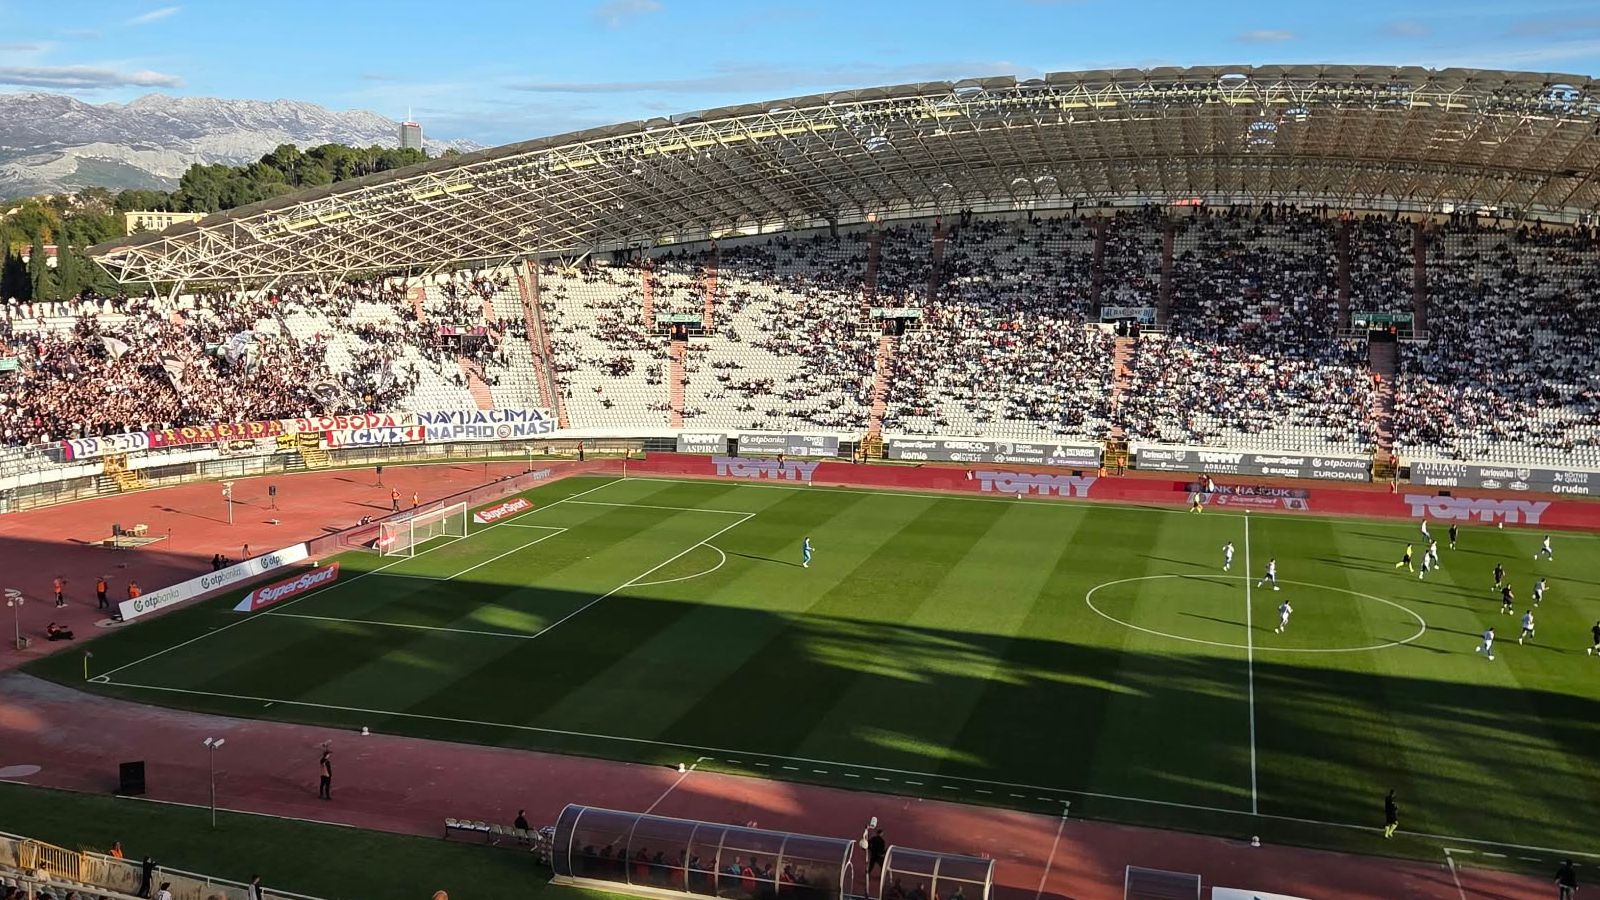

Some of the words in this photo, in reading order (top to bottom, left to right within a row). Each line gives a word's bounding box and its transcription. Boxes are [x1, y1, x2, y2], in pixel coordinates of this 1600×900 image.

[296, 413, 395, 431] SLOBODA
[332, 426, 420, 445] MCMXI
[427, 425, 494, 441] NAPRID
[682, 434, 721, 444] TOMMY
[751, 436, 785, 444] otpbanka
[893, 440, 936, 449] SuperSport
[1197, 451, 1243, 464] TOMMY
[1254, 456, 1304, 465] SuperSport
[1324, 460, 1366, 469] otpbanka
[712, 456, 821, 481] TOMMY
[1204, 463, 1238, 471] ADRIATIC
[1418, 463, 1467, 472] ADRIATIC
[975, 470, 1098, 497] TOMMY
[483, 498, 528, 521] SuperSport
[1405, 494, 1552, 524] TOMMY
[210, 566, 242, 586] otpbanka
[256, 567, 334, 604] SuperSport
[145, 588, 180, 608] otpbanka
